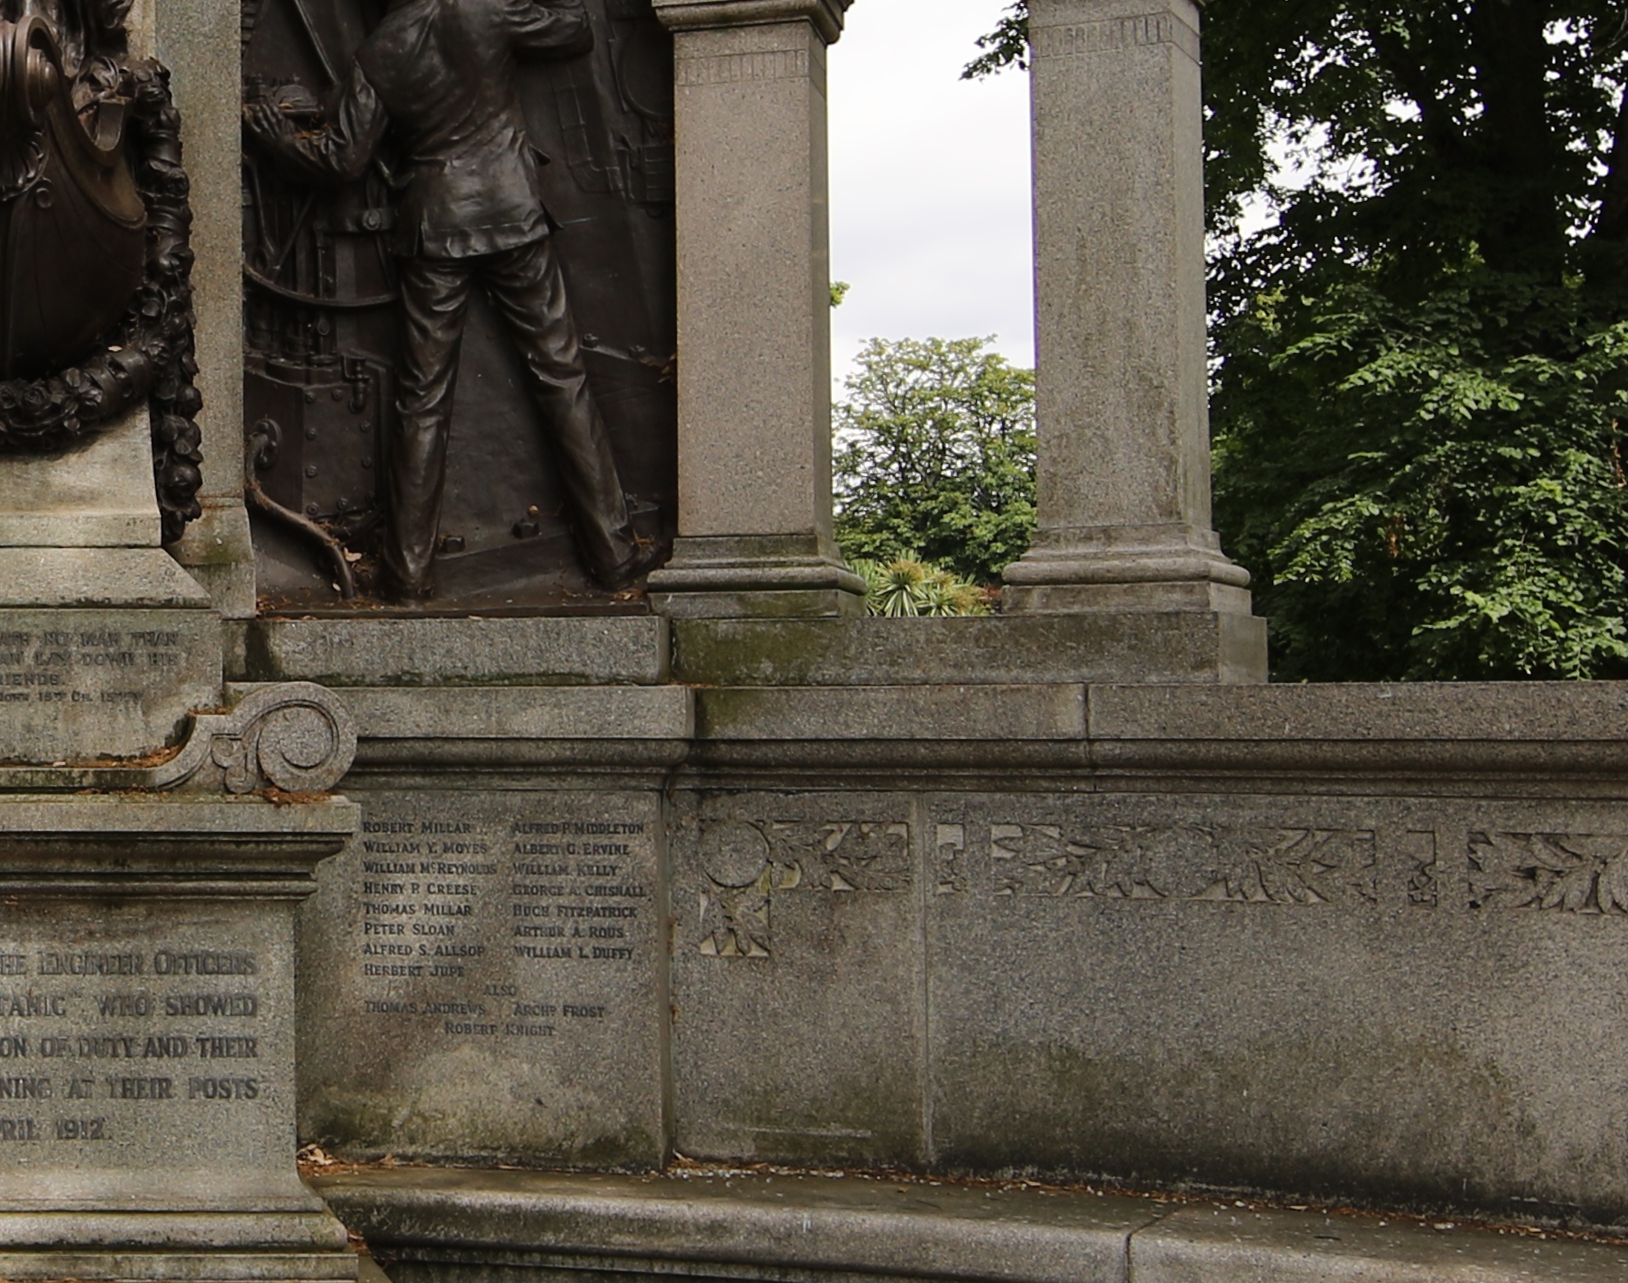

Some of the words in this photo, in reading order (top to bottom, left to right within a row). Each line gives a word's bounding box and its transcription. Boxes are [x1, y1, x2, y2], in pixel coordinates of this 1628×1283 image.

[44, 629, 68, 647] NO
[132, 629, 179, 647] THAN
[363, 821, 414, 834] ROBERT
[420, 821, 472, 834] MILLAR
[363, 841, 420, 854] WILLIAM
[442, 841, 488, 854] MOYES
[513, 843, 562, 855] ALBERT
[583, 843, 630, 855] ERVINE
[363, 861, 415, 874] WILLIAM
[363, 882, 404, 895] HENRY
[427, 882, 478, 895] CREESE
[512, 884, 564, 897] GEORGE
[363, 903, 416, 916] THOMAS
[424, 903, 472, 916] MILLAR
[557, 905, 638, 918] FITZPATRICK
[364, 922, 405, 935] PETER
[413, 922, 455, 935] SLOAN
[363, 943, 413, 957] ALFRED
[434, 943, 486, 957] ALLSOP
[514, 946, 572, 960] WILLIAM
[592, 946, 634, 960] DUFFY
[38, 953, 144, 976] ENGINEER
[154, 953, 260, 976] OFFICERS
[364, 963, 424, 977] HERBERT
[430, 963, 466, 977] JUPE
[96, 995, 152, 1017] WHO
[164, 995, 259, 1017] SHOWED
[364, 1000, 418, 1015] THOMAS
[562, 1003, 607, 1018] FROST
[444, 1022, 498, 1036] ROBERT
[40, 1036, 69, 1058] OF
[79, 1036, 135, 1058] DUTY
[144, 1036, 188, 1058] AND
[195, 1036, 259, 1058] THEIR
[66, 1076, 95, 1100] AT
[106, 1076, 174, 1100] THEIR
[188, 1076, 260, 1100] POSTS
